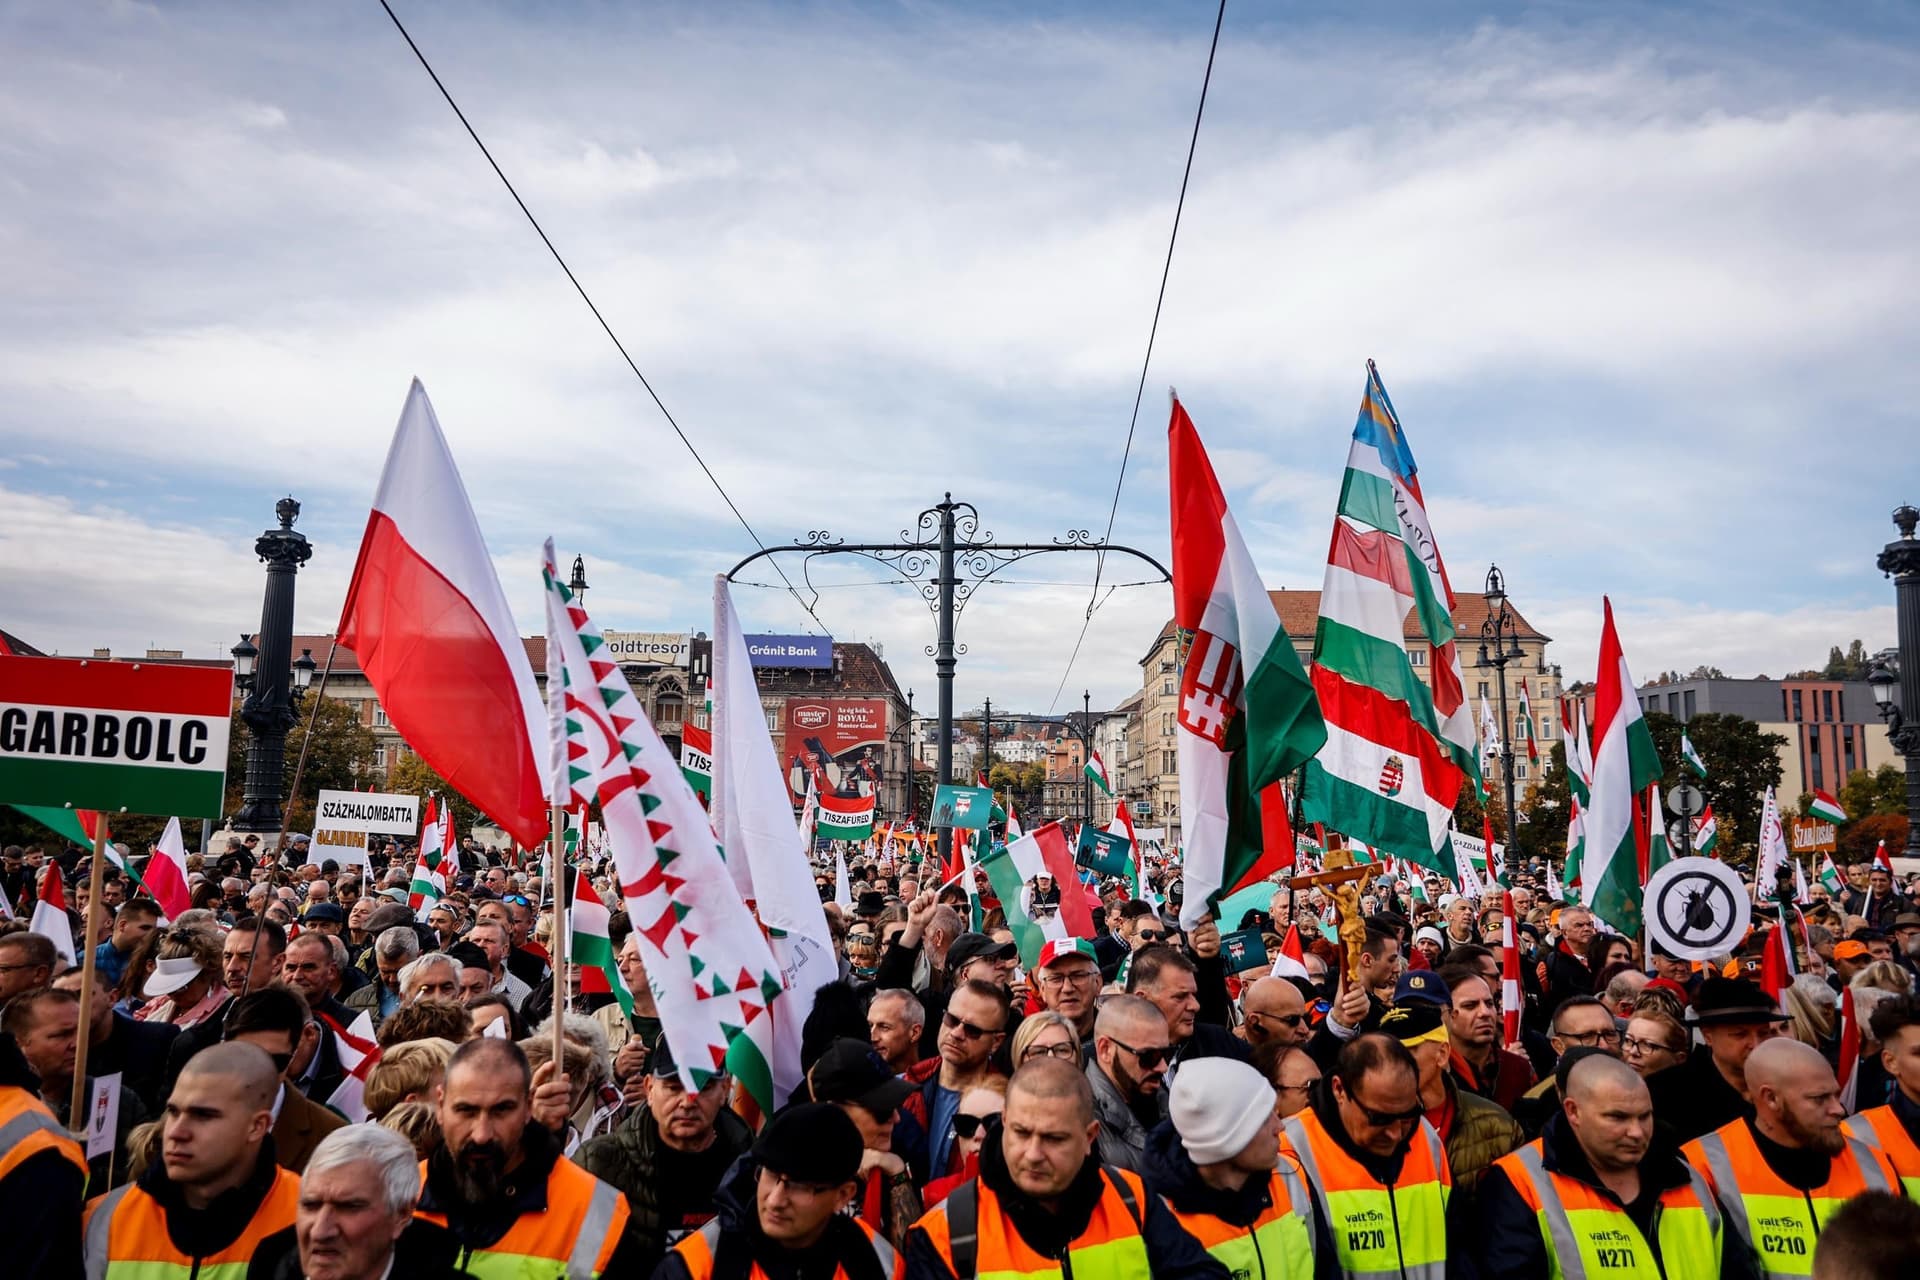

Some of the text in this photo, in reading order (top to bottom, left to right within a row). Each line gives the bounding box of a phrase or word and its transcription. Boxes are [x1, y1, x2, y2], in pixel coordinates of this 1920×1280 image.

[606, 640, 688, 653] oldtresor
[750, 645, 817, 657] Gránit Bank
[801, 716, 822, 724] good
[0, 708, 208, 764] GARBOLC
[688, 752, 712, 772] TISZ
[322, 800, 412, 823] SZÁZHALOMBATTA
[1348, 1229, 1385, 1251] H270
[1761, 1234, 1807, 1255] C210
[1596, 1248, 1635, 1268] H277
